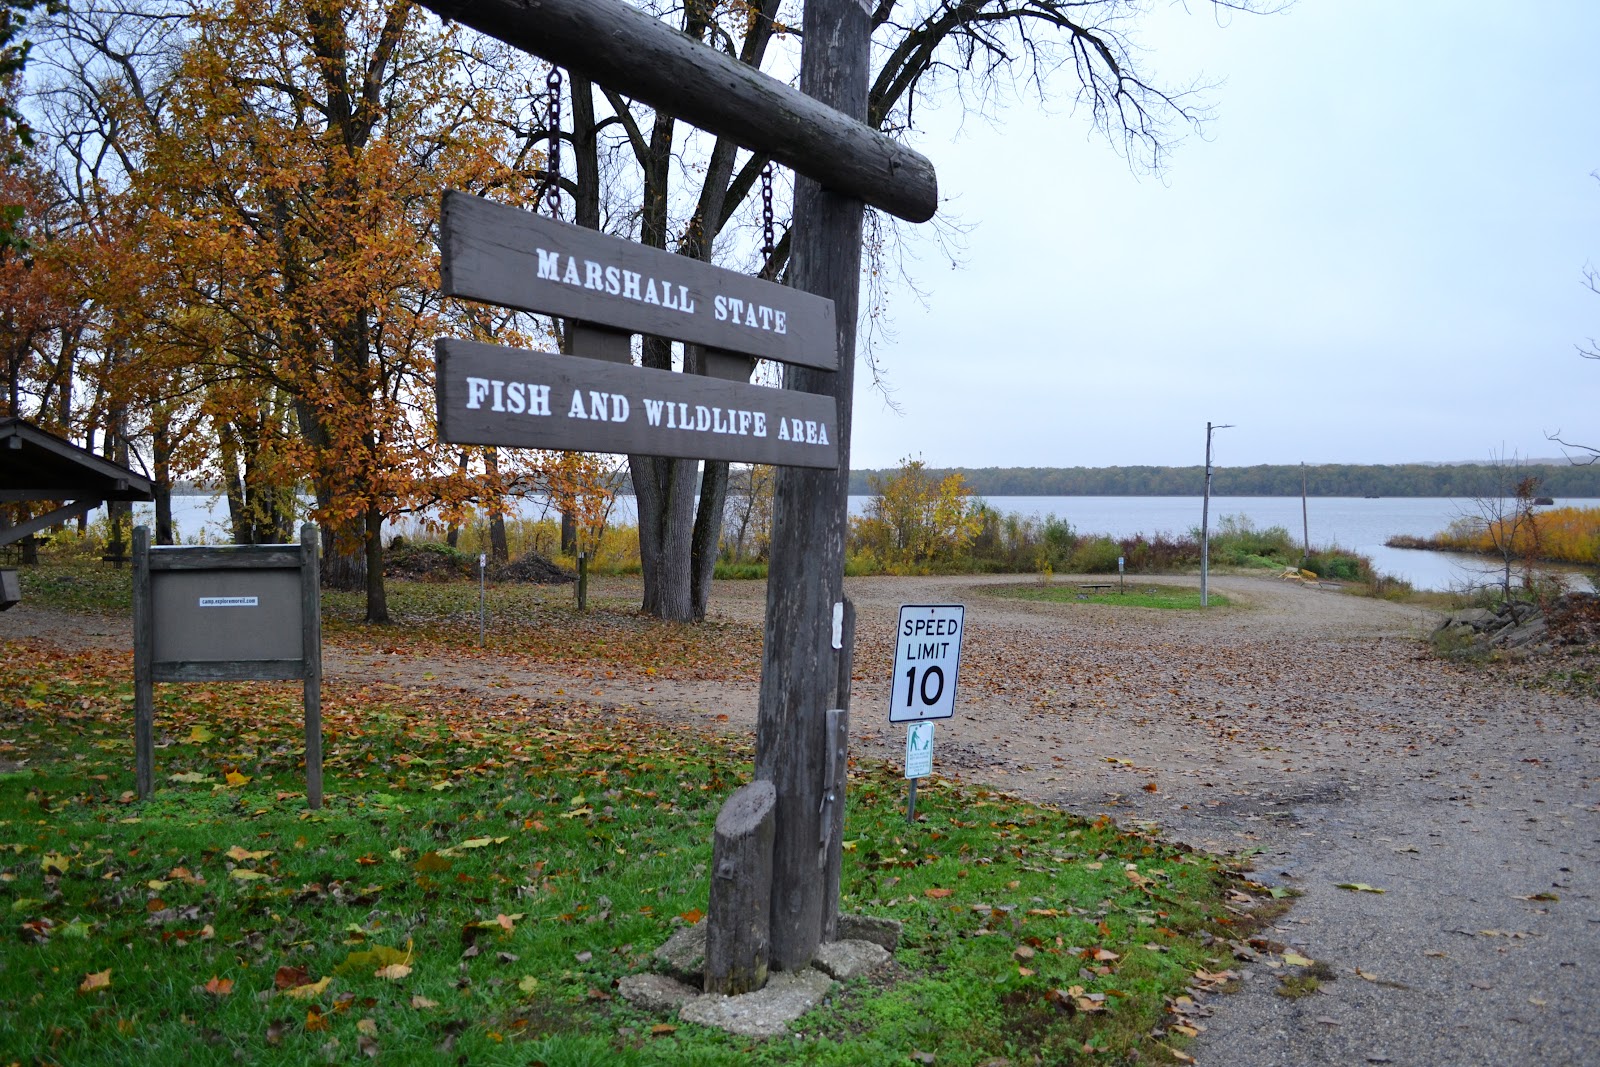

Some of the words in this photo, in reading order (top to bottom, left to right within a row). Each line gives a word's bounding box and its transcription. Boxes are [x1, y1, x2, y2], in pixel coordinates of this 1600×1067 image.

[536, 248, 695, 314] MARSHALL
[714, 294, 787, 335] STATE
[466, 376, 552, 417] FISH
[568, 389, 630, 423] AND
[643, 398, 767, 438] WILDLIFE
[778, 416, 830, 446] AREA
[903, 619, 958, 636] SPEED
[907, 642, 950, 660] LIMIT
[906, 665, 944, 707] 10
